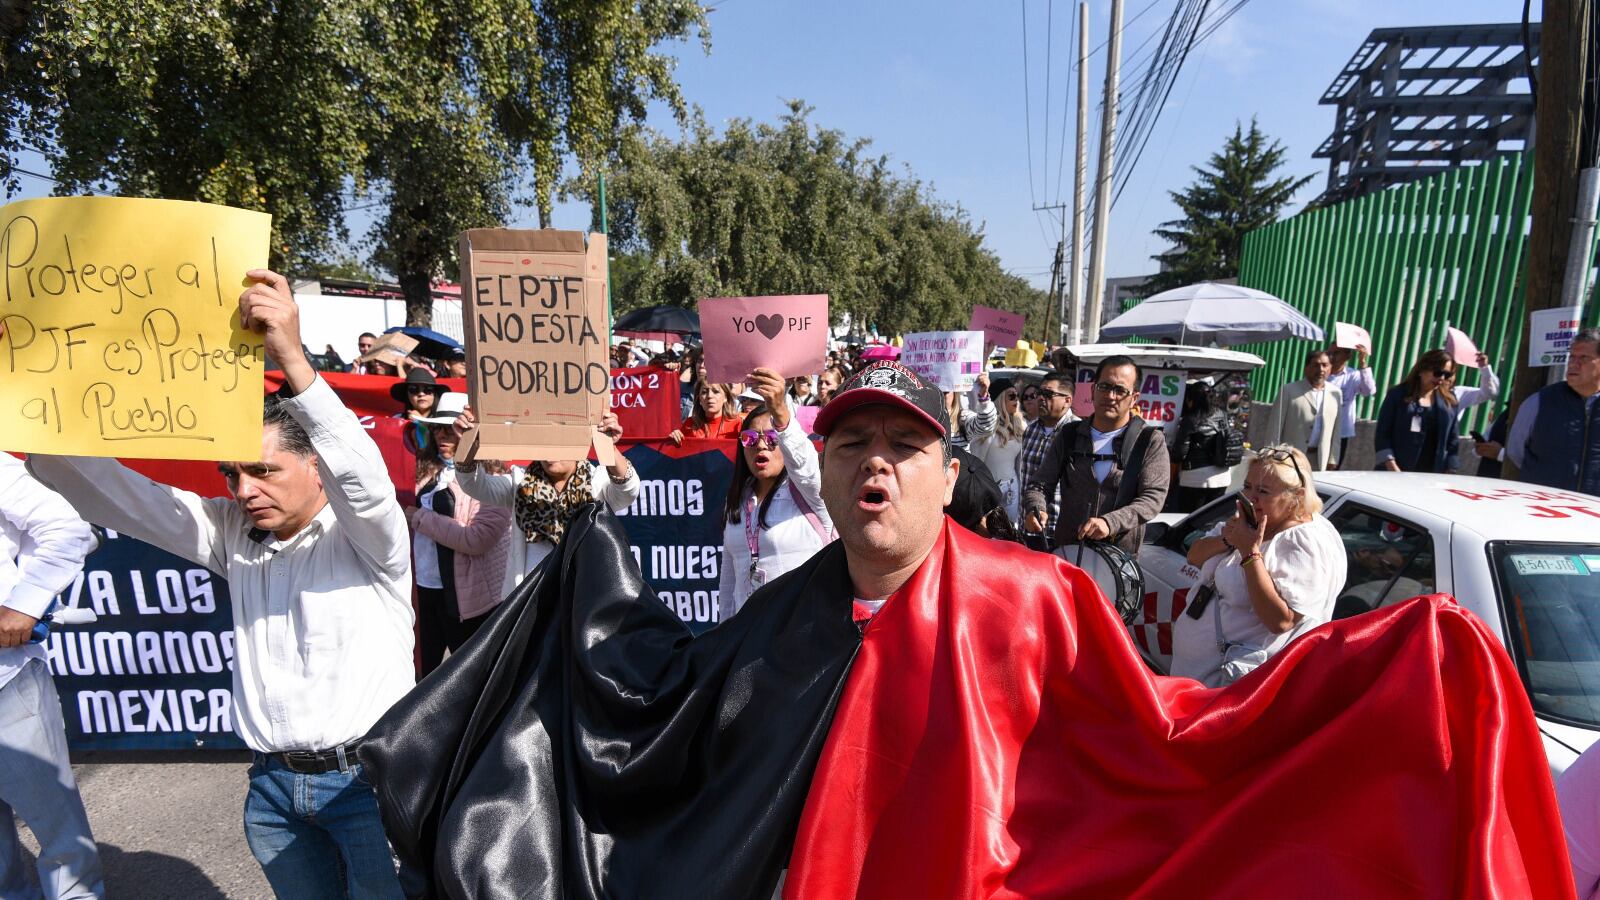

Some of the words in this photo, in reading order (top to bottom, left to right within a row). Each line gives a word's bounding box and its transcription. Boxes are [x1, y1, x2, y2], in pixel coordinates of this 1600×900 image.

[1, 215, 155, 314] Proteger
[176, 236, 222, 306] al
[519, 275, 583, 309] PJF
[478, 312, 524, 343] NO
[532, 313, 599, 345] ESTA
[732, 317, 755, 333] Yo
[788, 317, 812, 332] PJF
[1, 314, 95, 373] PJF
[103, 339, 143, 375] es
[142, 308, 264, 392] Proteger
[480, 355, 609, 398] PODRIDO
[610, 372, 643, 390] IÓN
[648, 373, 659, 388] 2
[22, 387, 61, 433] al
[82, 382, 197, 436] Pueblo
[610, 392, 646, 408] UCA
[615, 479, 704, 516] MOS
[130, 569, 216, 615] LOS
[77, 688, 233, 733] MEXICA
